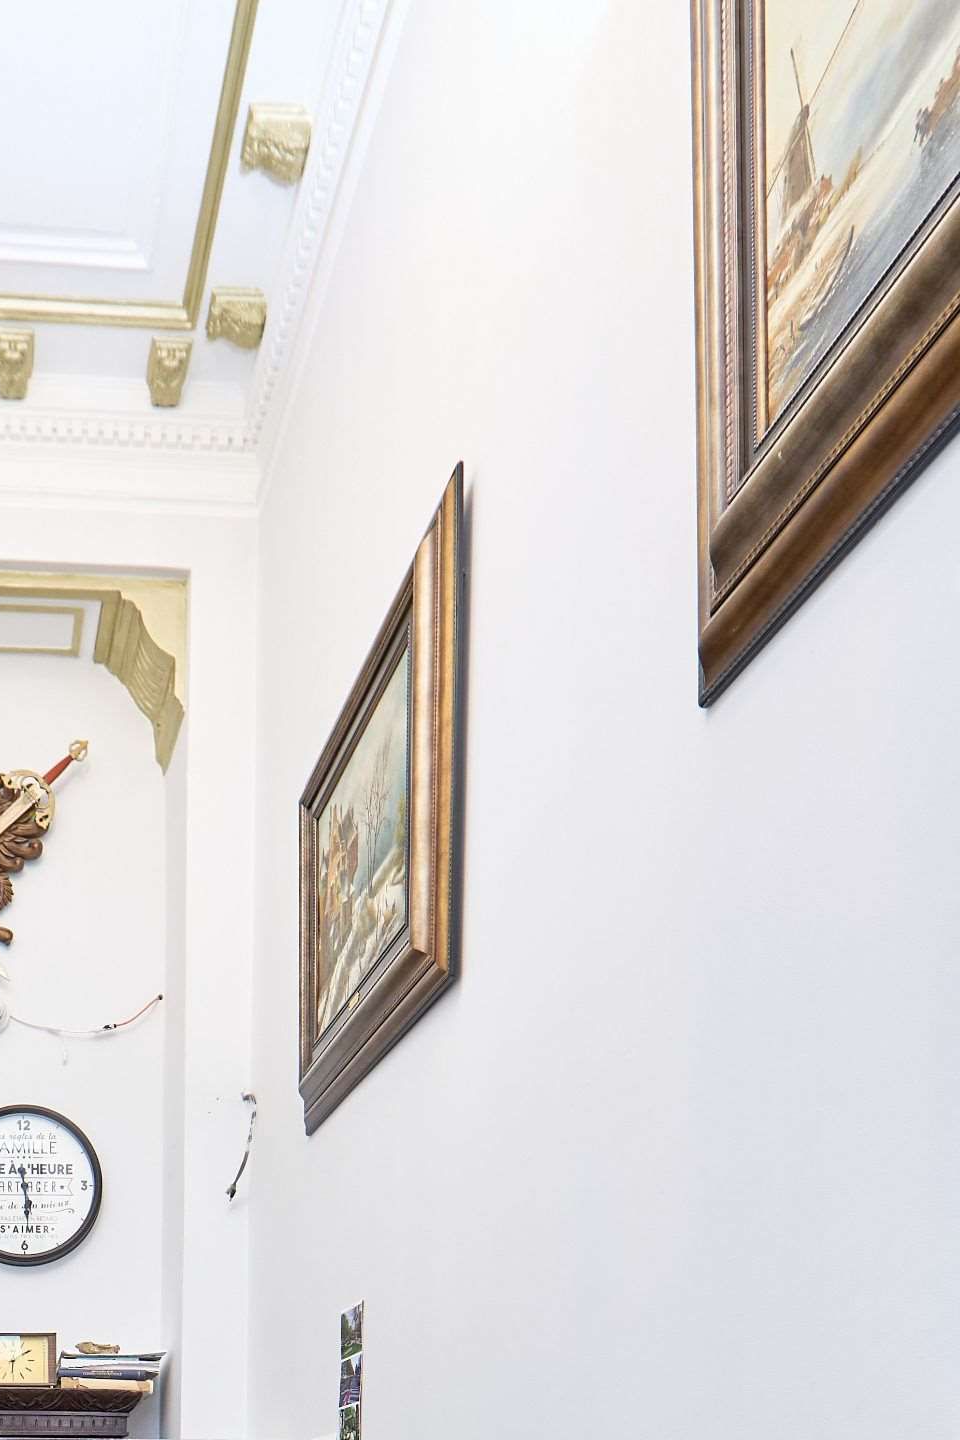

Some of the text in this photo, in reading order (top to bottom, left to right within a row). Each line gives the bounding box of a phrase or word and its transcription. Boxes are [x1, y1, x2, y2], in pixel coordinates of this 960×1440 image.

[17, 1120, 31, 1131] 12
[8, 1160, 19, 1175] À
[80, 1180, 88, 1190] 3
[8, 1201, 17, 1210] de
[0, 1225, 50, 1234] S'AIMER
[21, 1240, 29, 1251] 6
